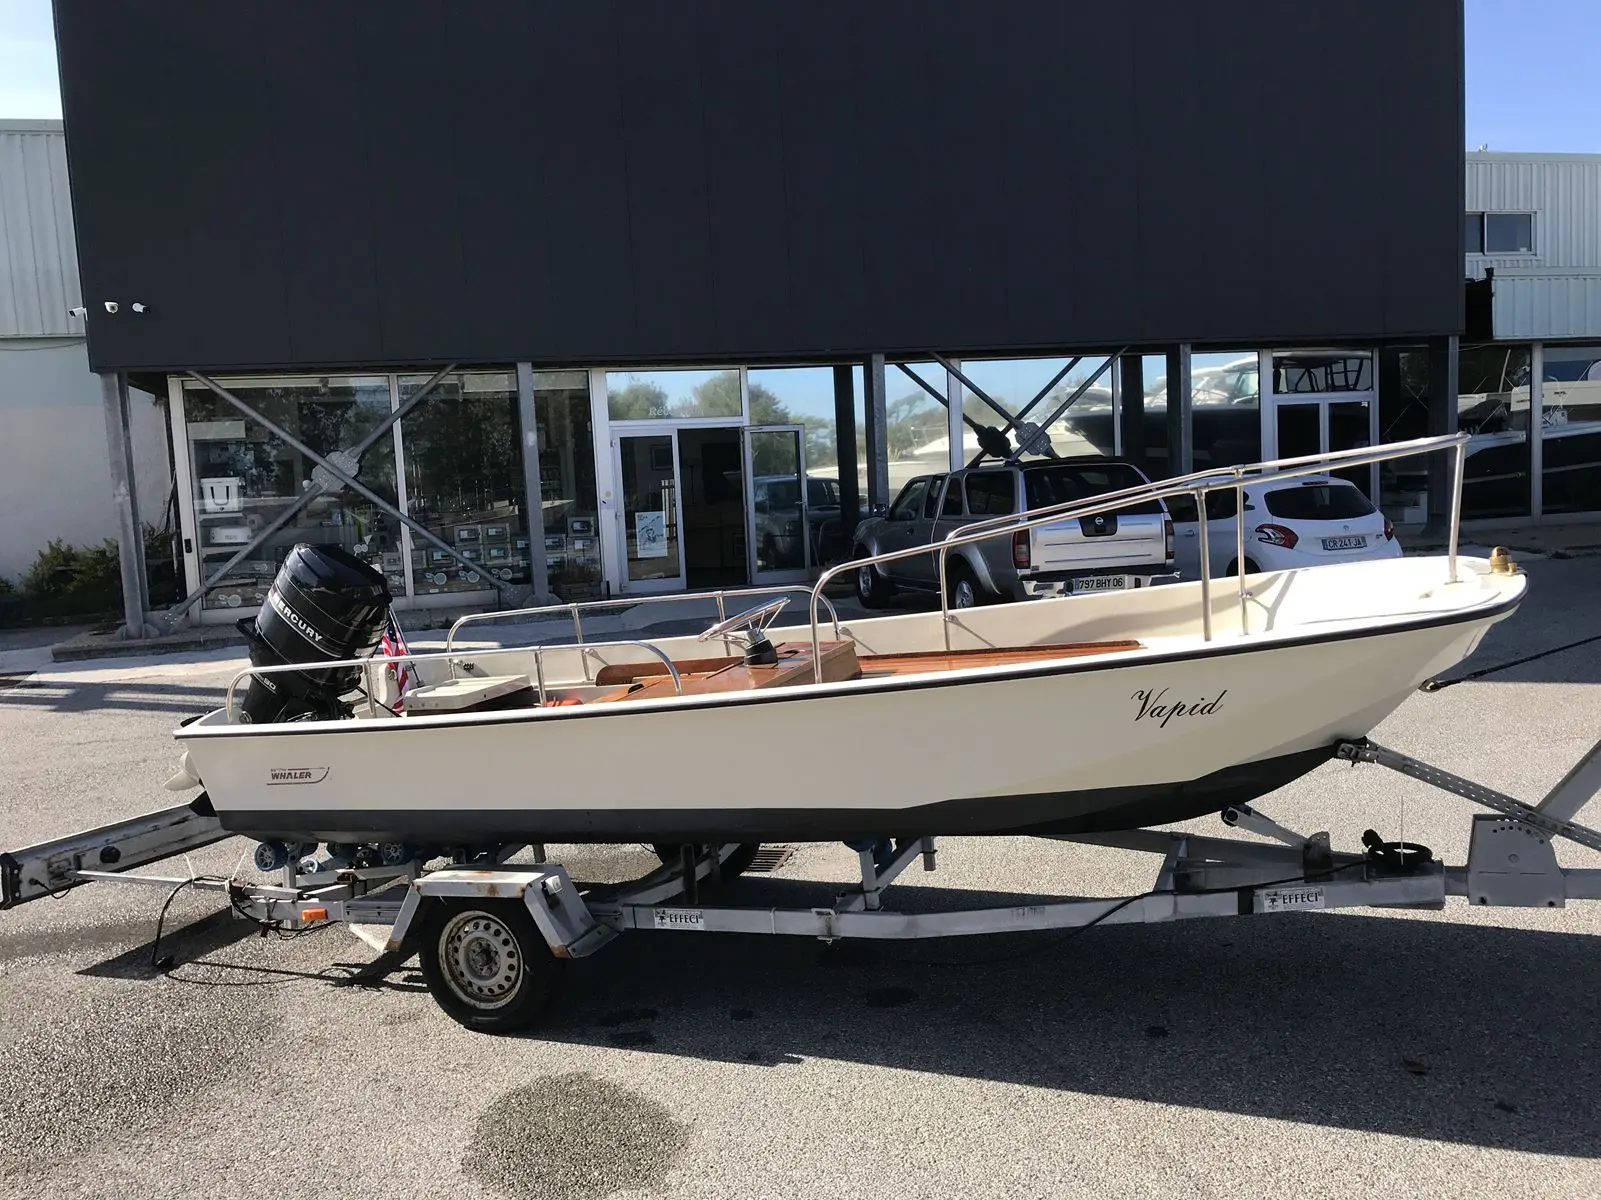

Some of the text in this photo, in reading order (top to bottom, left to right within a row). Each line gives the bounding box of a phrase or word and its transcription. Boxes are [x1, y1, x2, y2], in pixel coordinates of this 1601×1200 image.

[1328, 537, 1362, 549] CR 241 JA
[1079, 577, 1123, 589] 797 BHY 06
[272, 591, 323, 642] MERCURY
[1130, 687, 1228, 729] Vapid
[271, 771, 312, 780] WHALER
